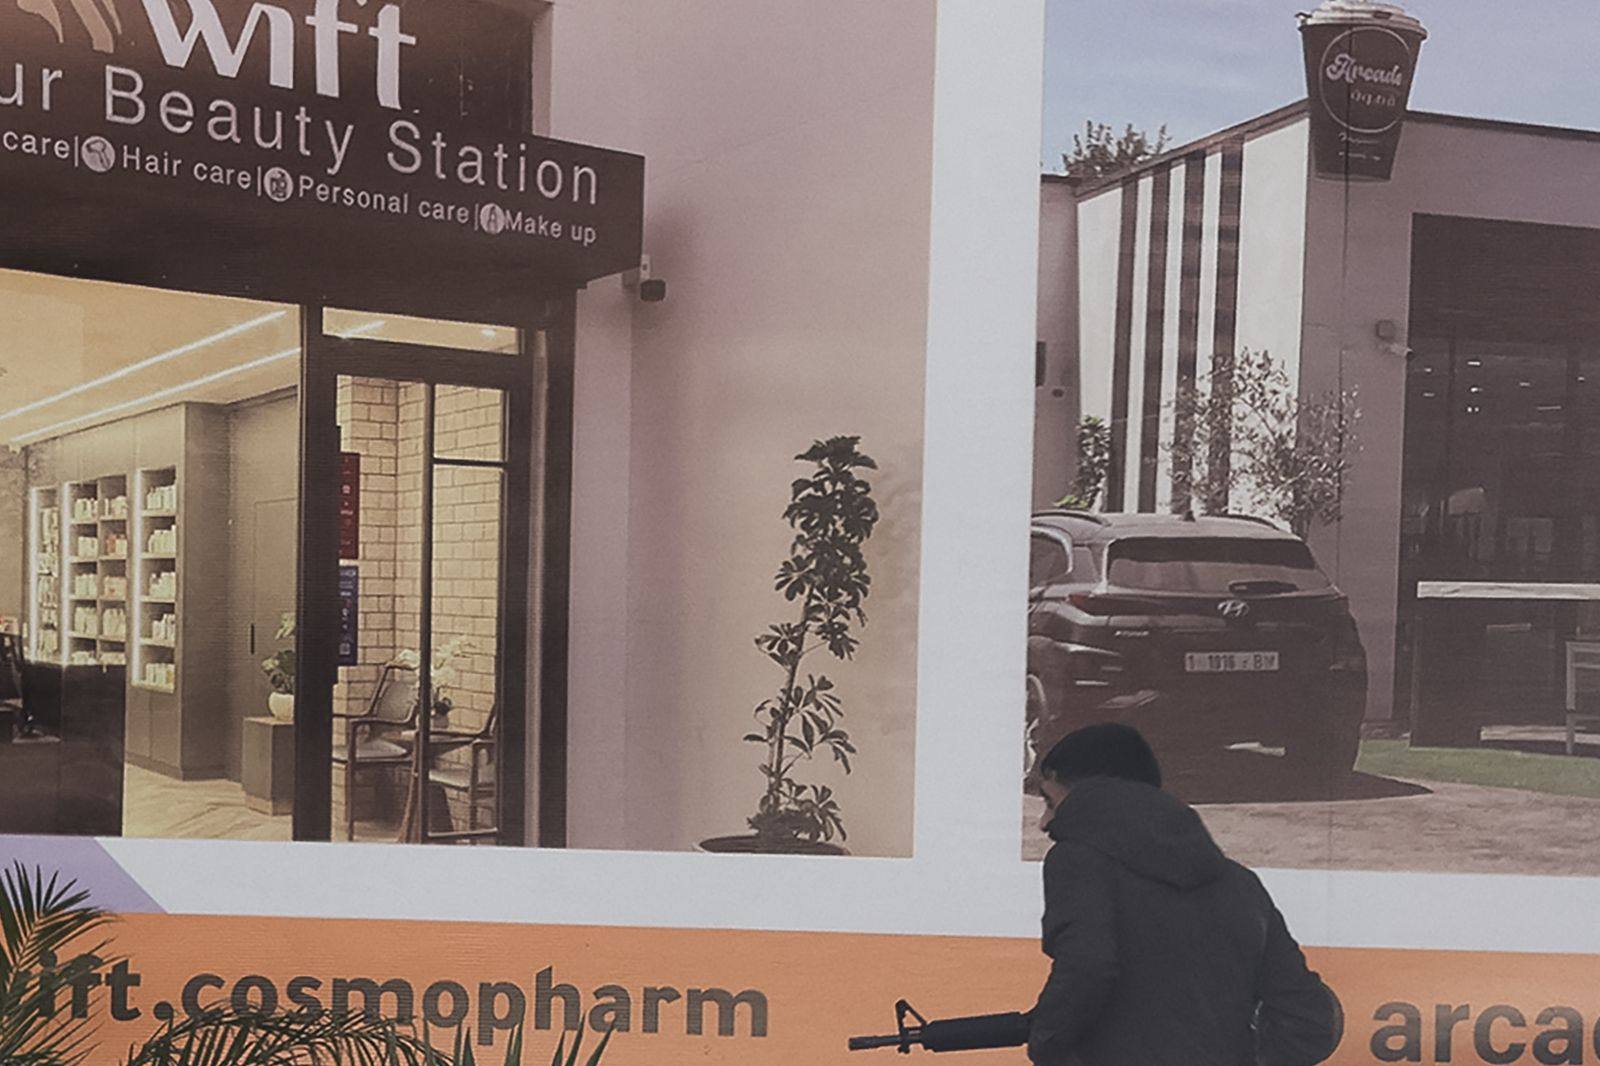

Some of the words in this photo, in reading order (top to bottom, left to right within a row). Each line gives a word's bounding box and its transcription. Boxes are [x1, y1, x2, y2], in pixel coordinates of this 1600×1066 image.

[104, 64, 354, 176] Beauty
[386, 119, 598, 205] Station
[123, 145, 182, 176] Hair
[299, 174, 409, 215] Personal
[504, 209, 562, 238] Make
[570, 224, 597, 247] up
[1369, 1000, 1600, 1066] arca
